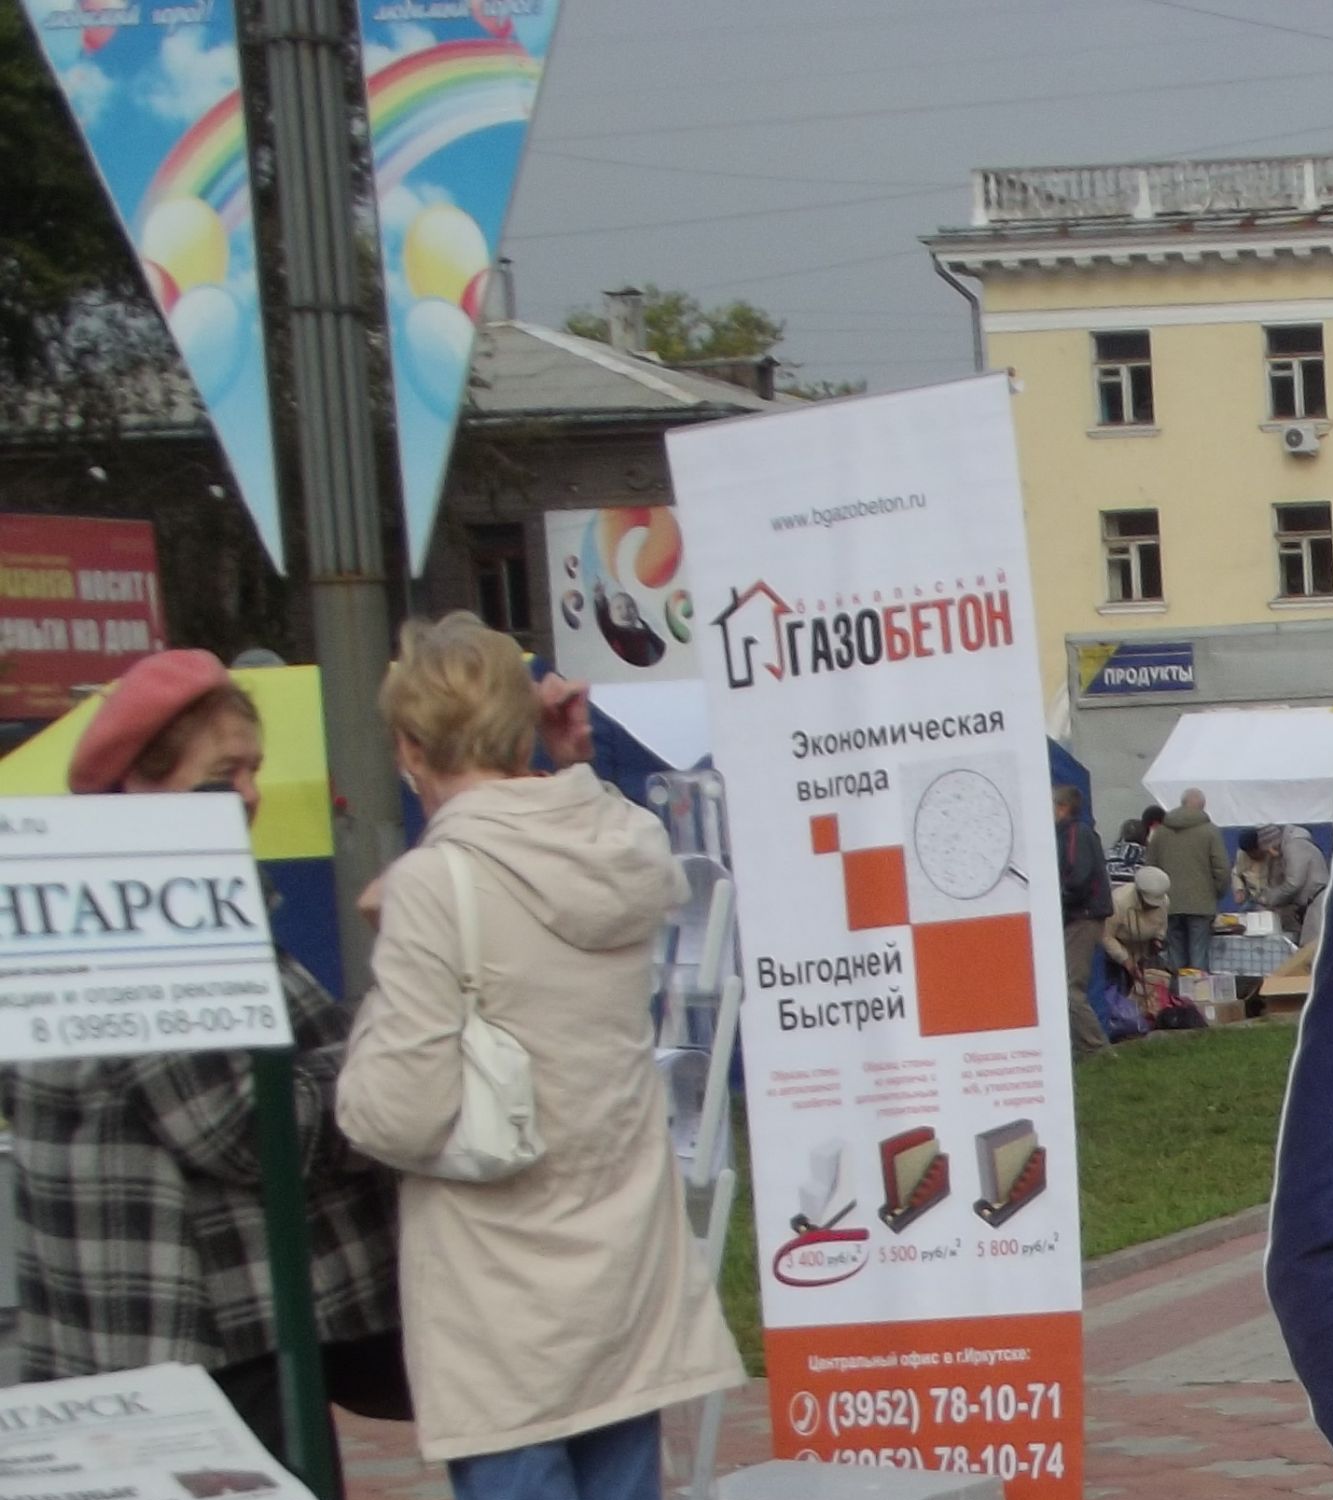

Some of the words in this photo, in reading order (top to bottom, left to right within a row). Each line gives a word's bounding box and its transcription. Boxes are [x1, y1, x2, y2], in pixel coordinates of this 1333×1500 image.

[770, 493, 927, 531] www.bgazobeton.ru
[785, 589, 1014, 677] ГАЗОБЕТОН
[1103, 664, 1194, 688] ПРОДУКТЫ
[791, 710, 1006, 759] Экономическая
[796, 769, 890, 802] выгода
[756, 941, 903, 990] Выгодней
[776, 986, 906, 1031] Быстрей
[827, 1387, 921, 1437] (3952)
[929, 1381, 1063, 1424] 78-10-71
[934, 1441, 1065, 1481] 78-10-74
